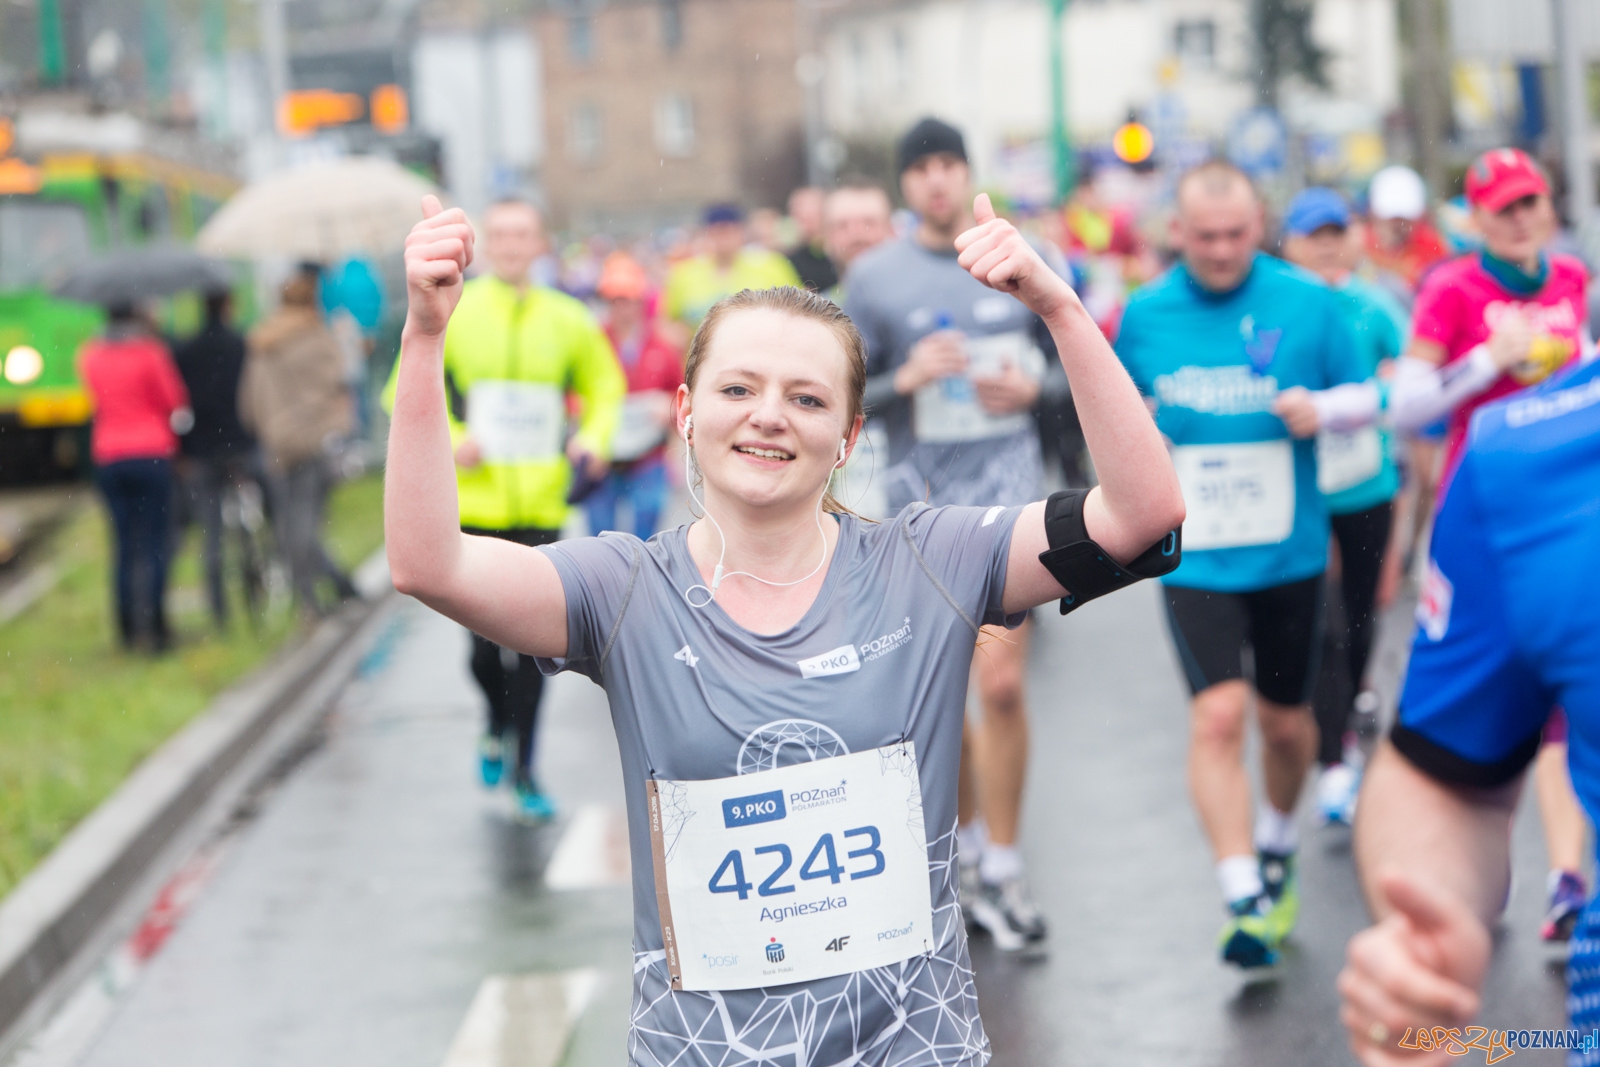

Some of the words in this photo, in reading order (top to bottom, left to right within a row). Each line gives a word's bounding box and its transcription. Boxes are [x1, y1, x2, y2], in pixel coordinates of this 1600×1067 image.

[863, 634, 913, 663] PÓŁMARATON
[792, 796, 847, 812] PÓŁMARATON
[708, 825, 885, 900] 4243
[760, 896, 847, 923] Agnieszka
[825, 935, 850, 951] 4F
